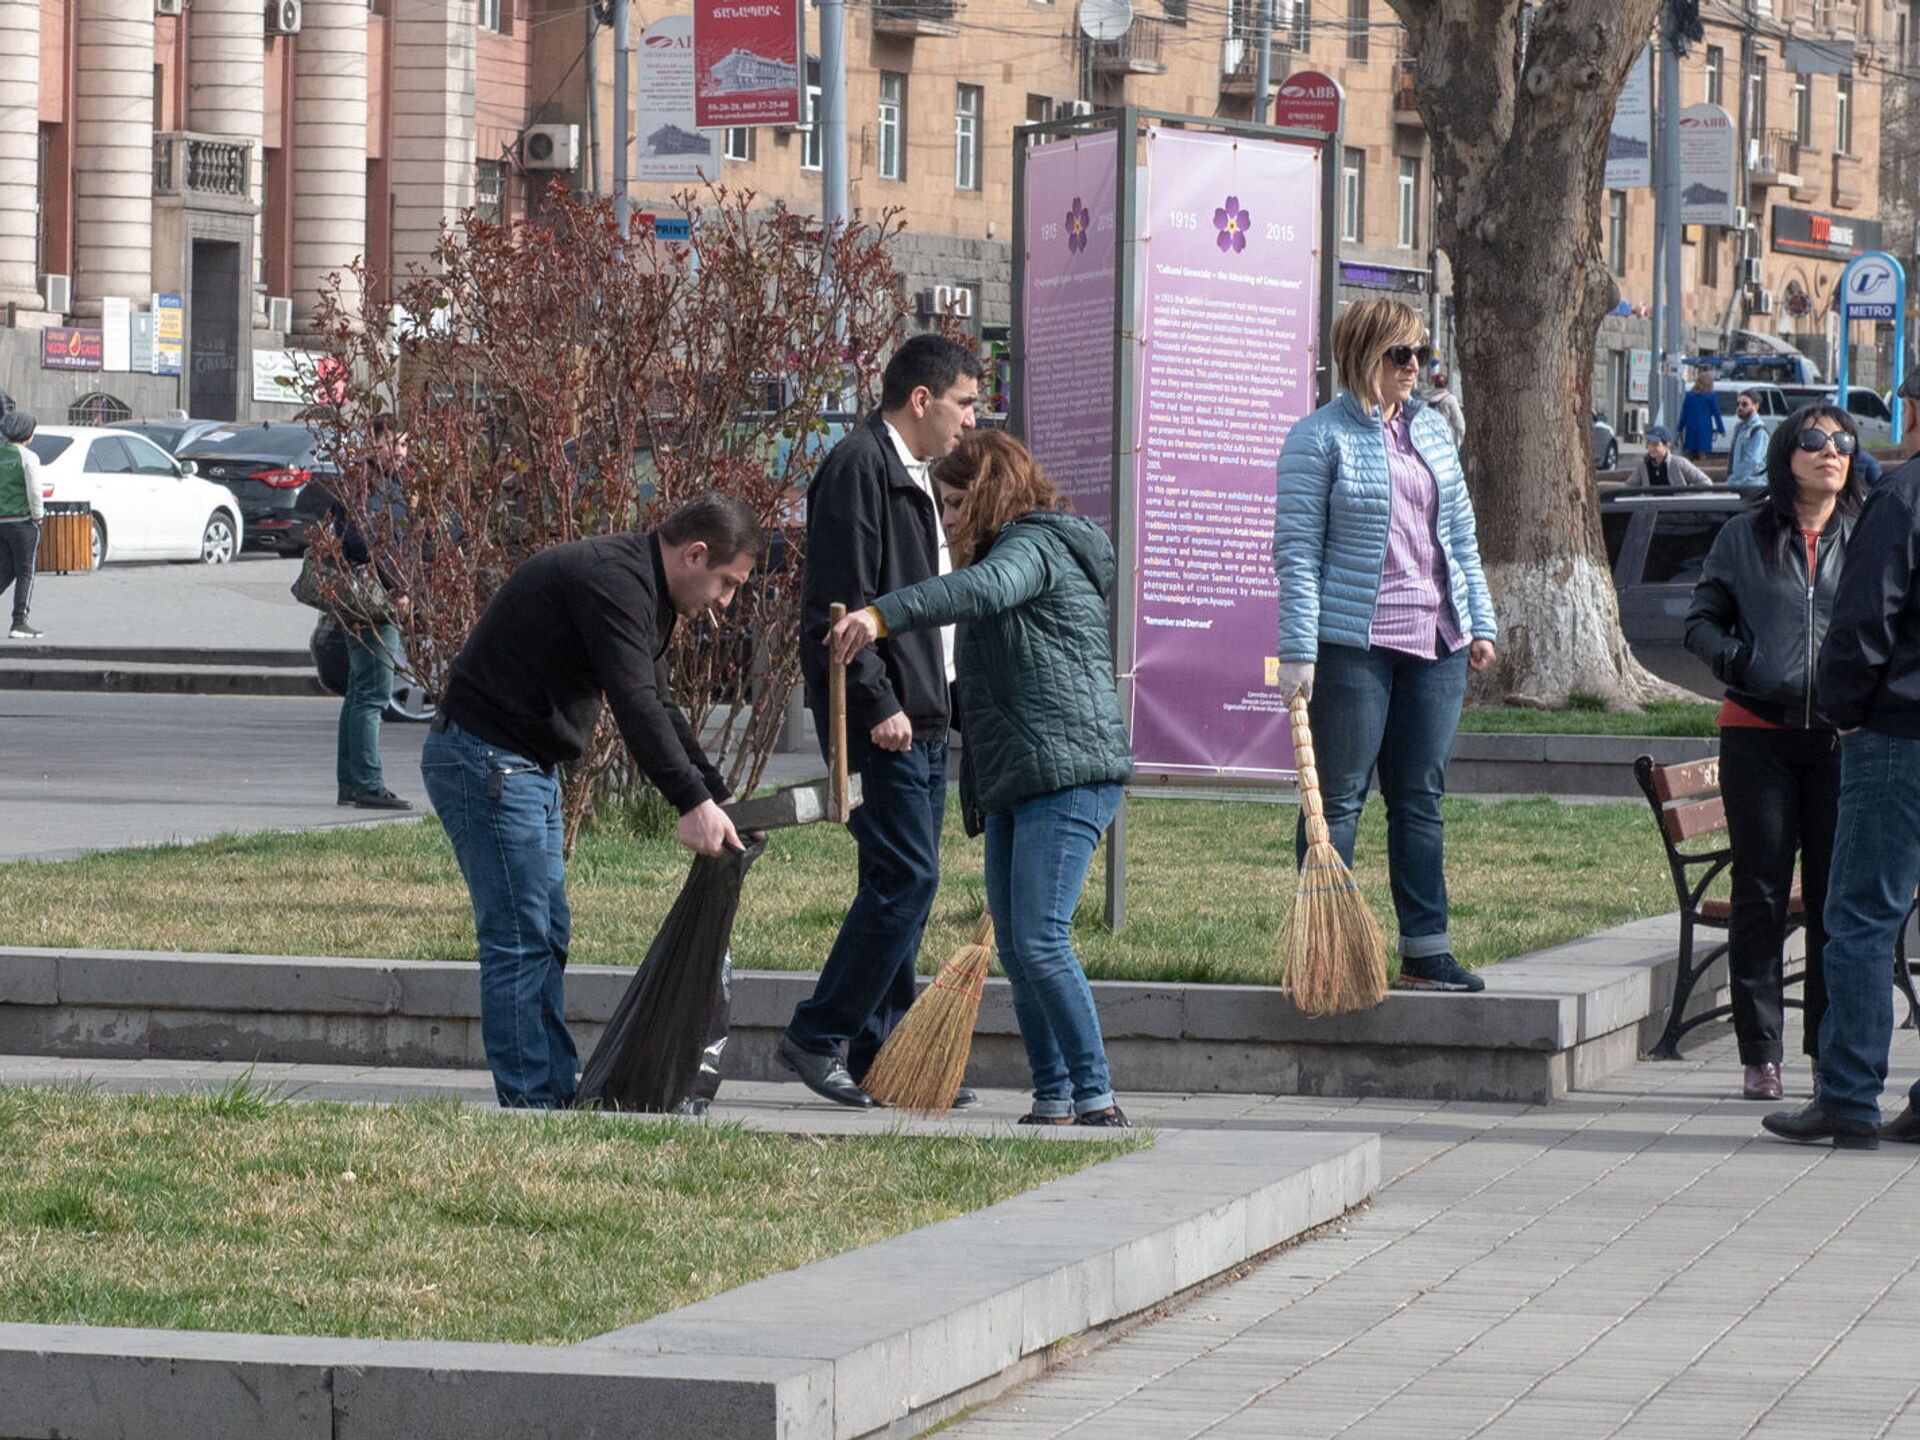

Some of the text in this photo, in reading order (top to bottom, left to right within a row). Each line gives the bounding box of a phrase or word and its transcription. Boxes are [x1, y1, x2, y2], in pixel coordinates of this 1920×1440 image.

[1306, 86, 1335, 98] ABB
[1169, 210, 1294, 241] 1915 2015
[1849, 305, 1892, 317] METRO
[1243, 517, 1274, 526] cross-stone
[1143, 581, 1184, 592] photographs
[1196, 585, 1237, 594] cross-stones
[1175, 618, 1186, 626] and
